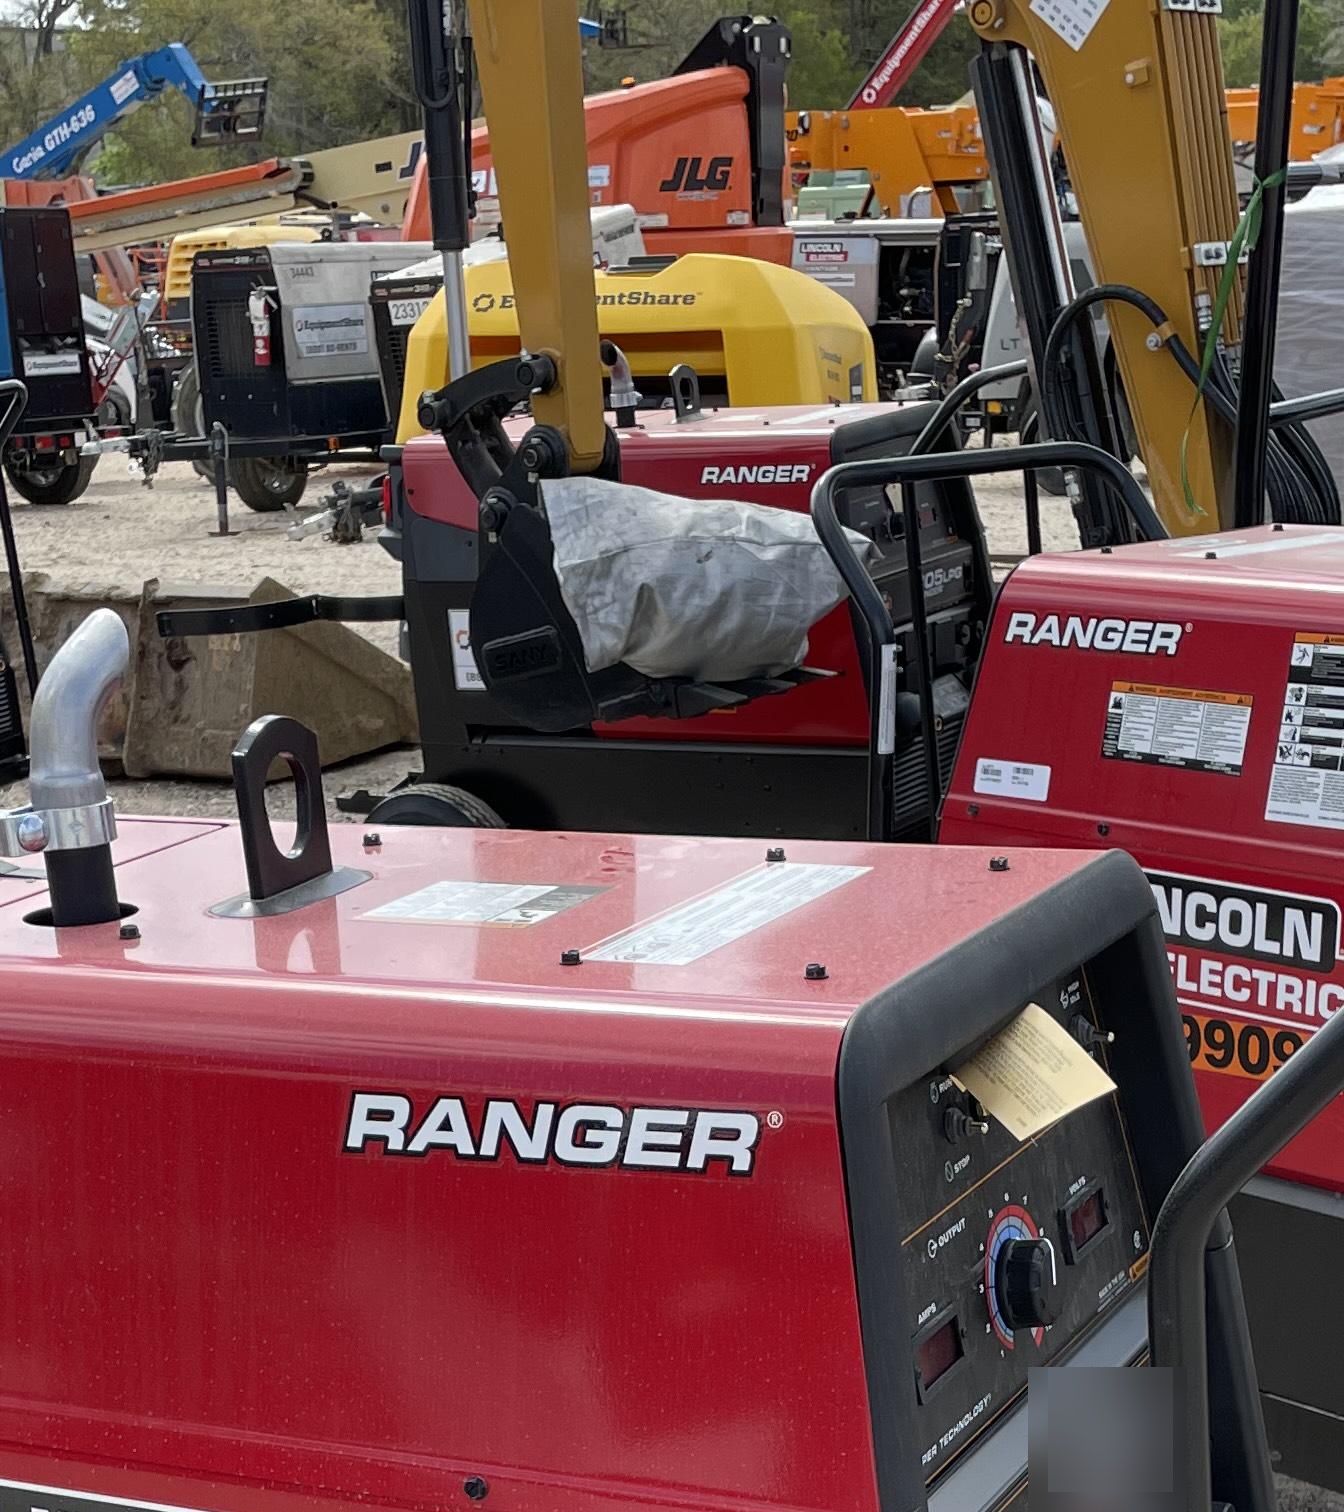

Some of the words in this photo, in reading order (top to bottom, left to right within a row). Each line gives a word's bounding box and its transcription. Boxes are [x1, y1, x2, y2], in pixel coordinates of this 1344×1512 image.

[43, 104, 96, 151] GTH-636
[659, 156, 733, 192] JLG
[800, 243, 842, 253] LINCOLN
[700, 464, 811, 485] RANGER
[953, 1154, 971, 1174] STOP
[937, 1217, 967, 1247] OUTPUT
[917, 1302, 938, 1325] AMPS
